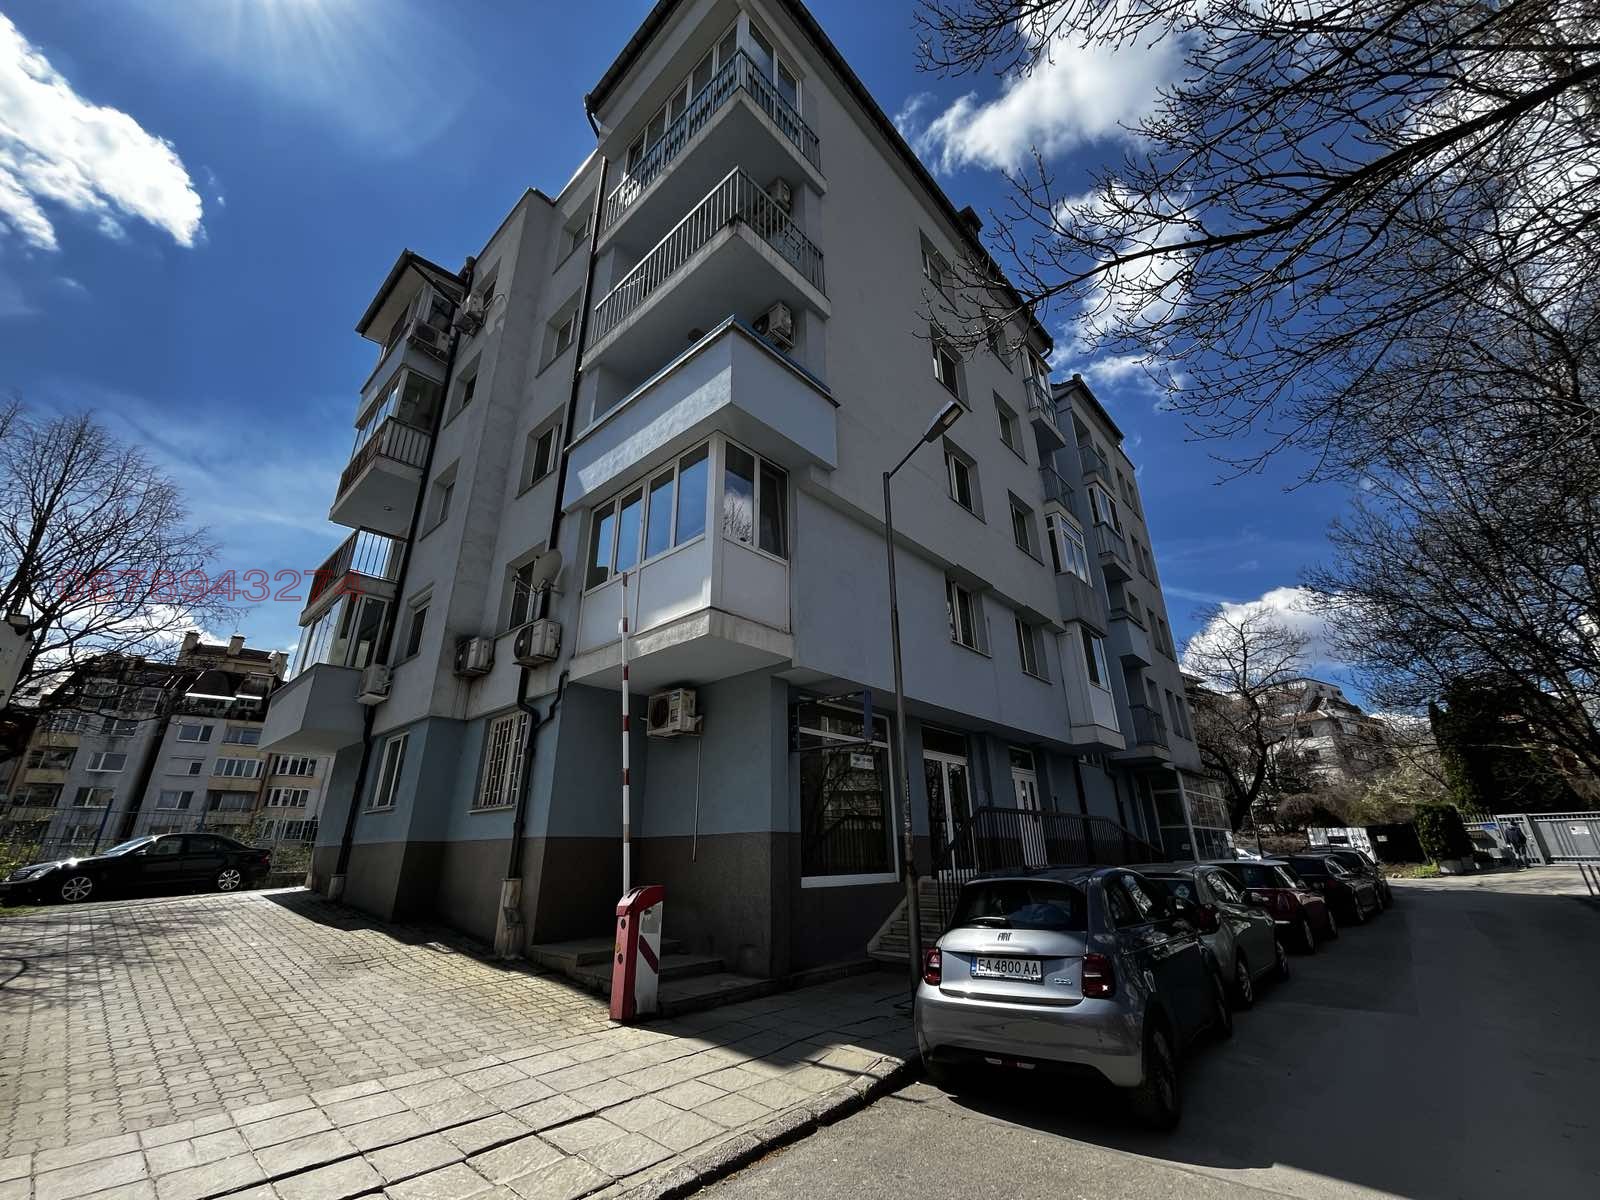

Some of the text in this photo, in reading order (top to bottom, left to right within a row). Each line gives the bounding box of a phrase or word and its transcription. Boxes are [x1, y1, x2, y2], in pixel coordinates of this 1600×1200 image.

[997, 932, 1012, 942] FIAT
[978, 959, 1038, 975] EA 4800 AA
